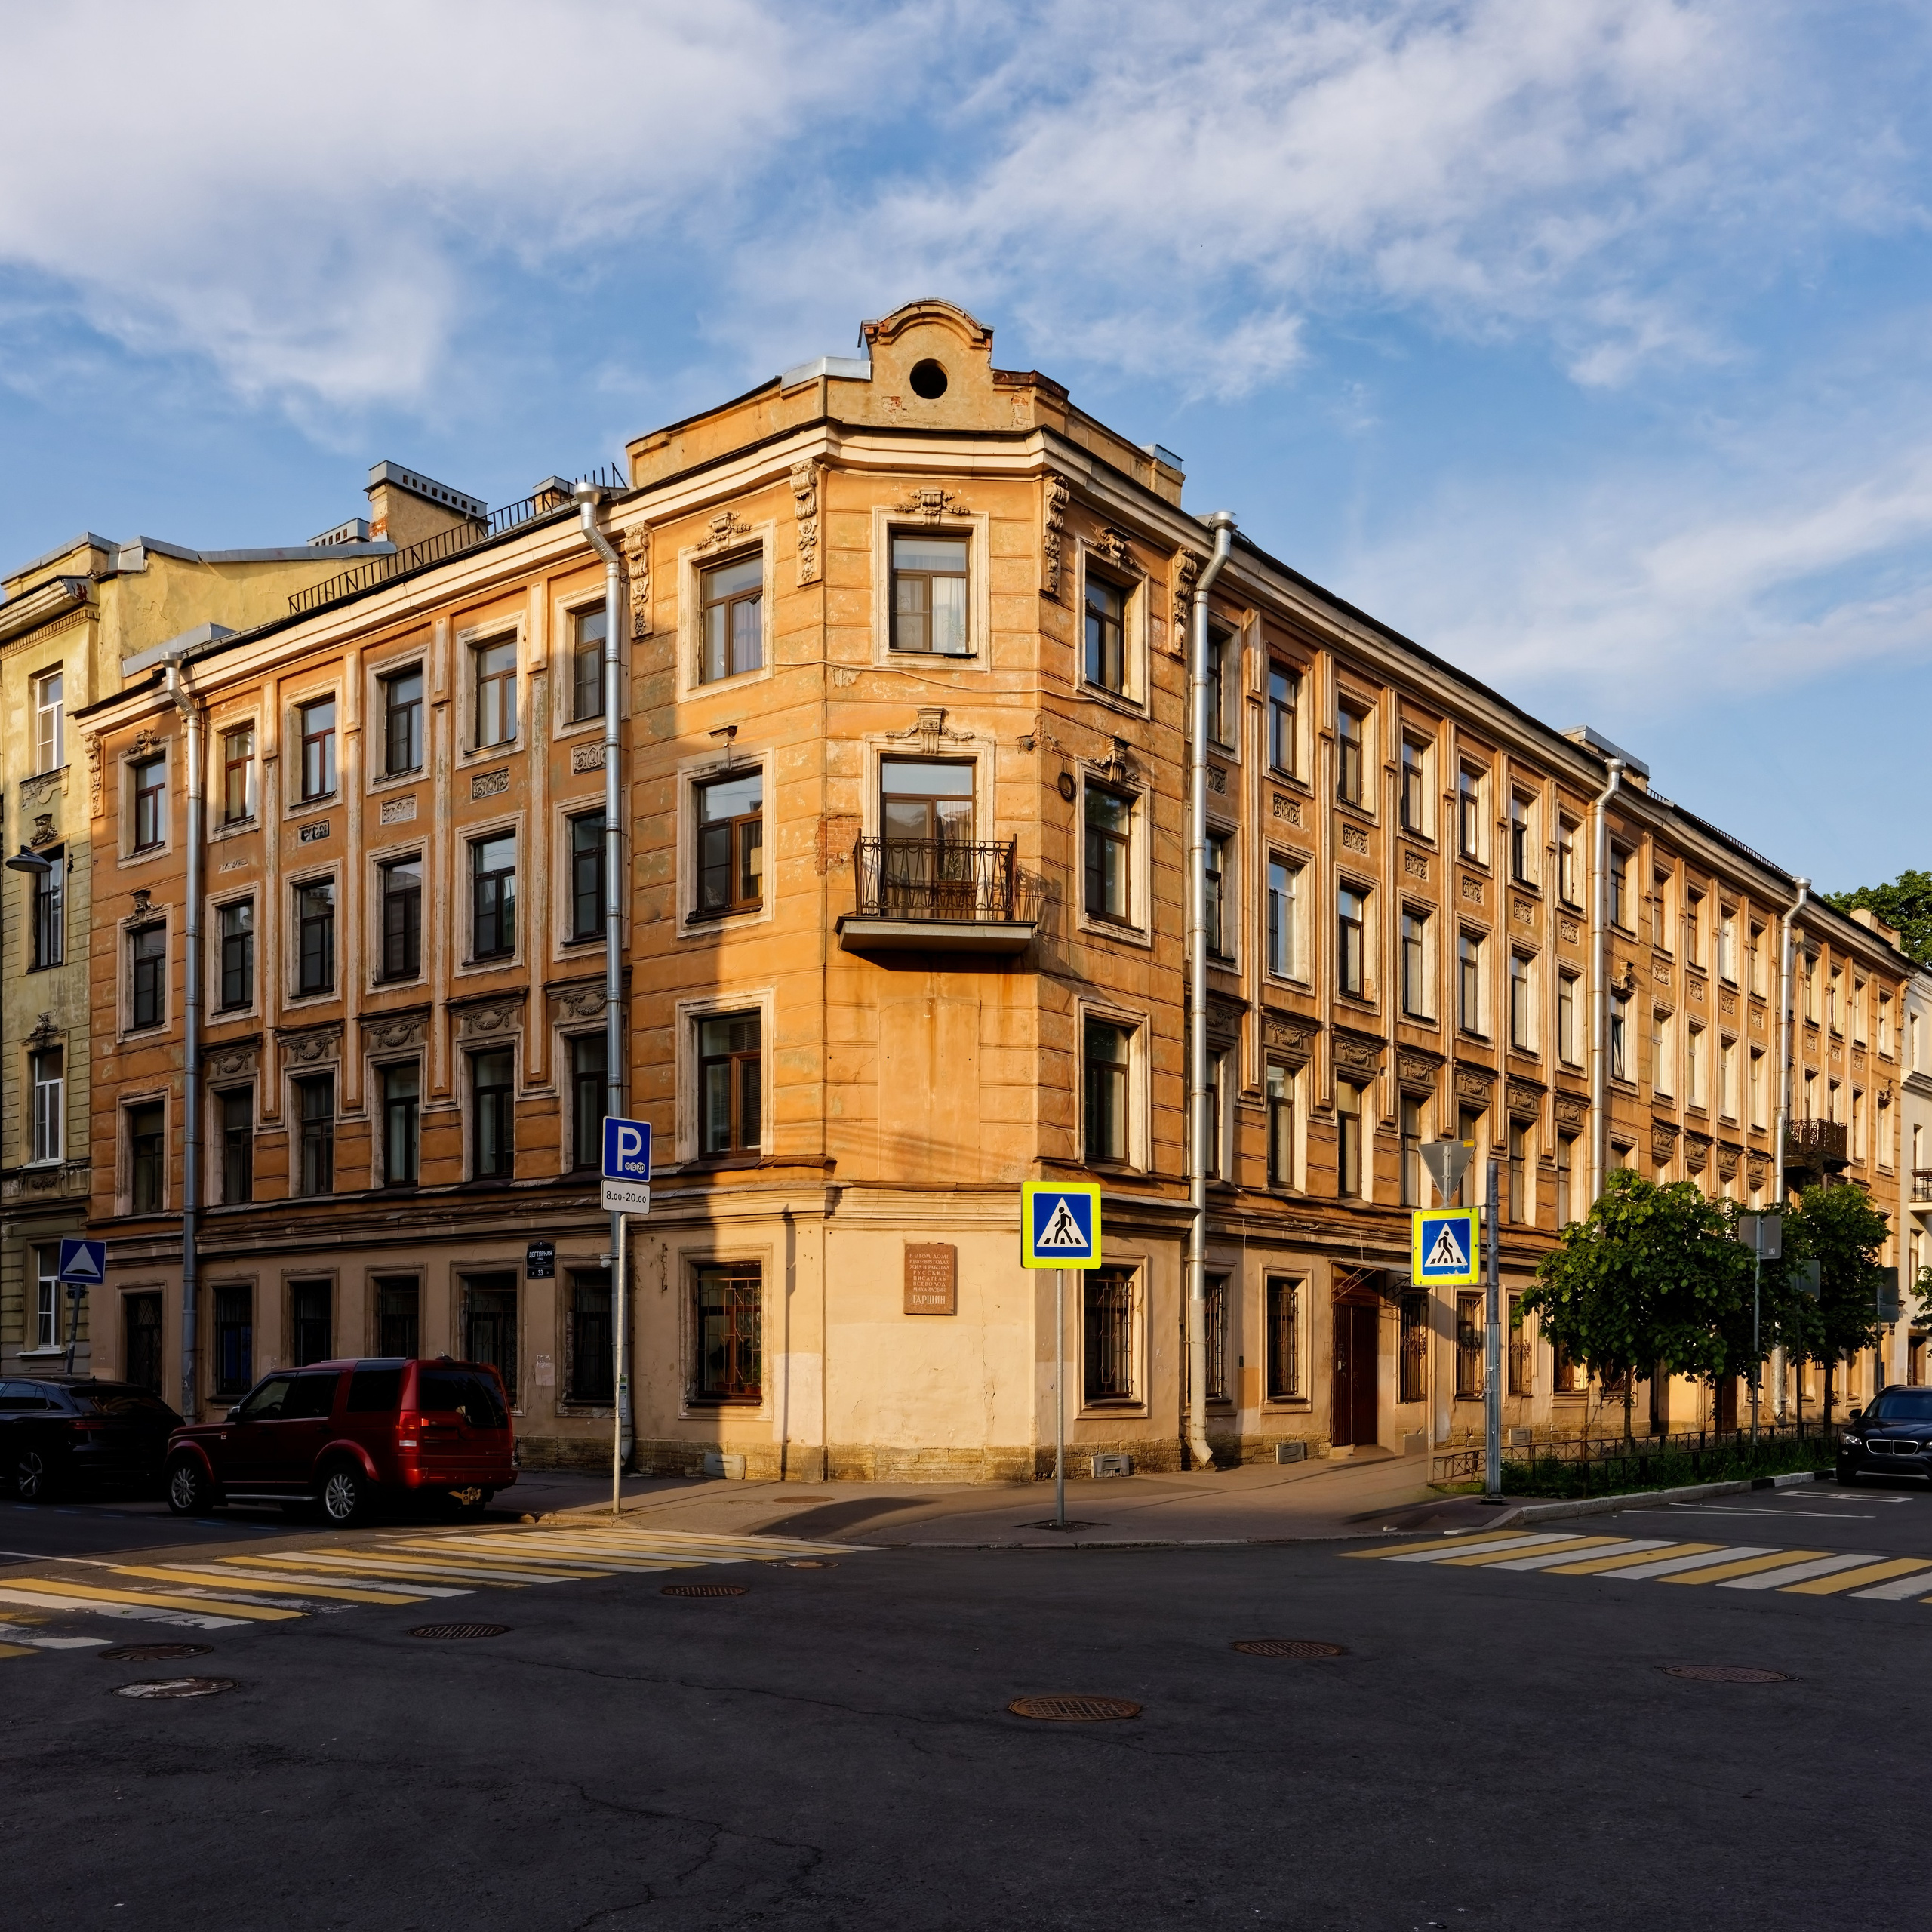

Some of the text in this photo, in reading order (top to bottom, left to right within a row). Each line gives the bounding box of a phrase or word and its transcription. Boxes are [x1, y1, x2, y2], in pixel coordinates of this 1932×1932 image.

[617, 1126, 642, 1171] P
[606, 1190, 646, 1203] 8.00-20.00
[913, 1295, 946, 1305] ГАРШИН
